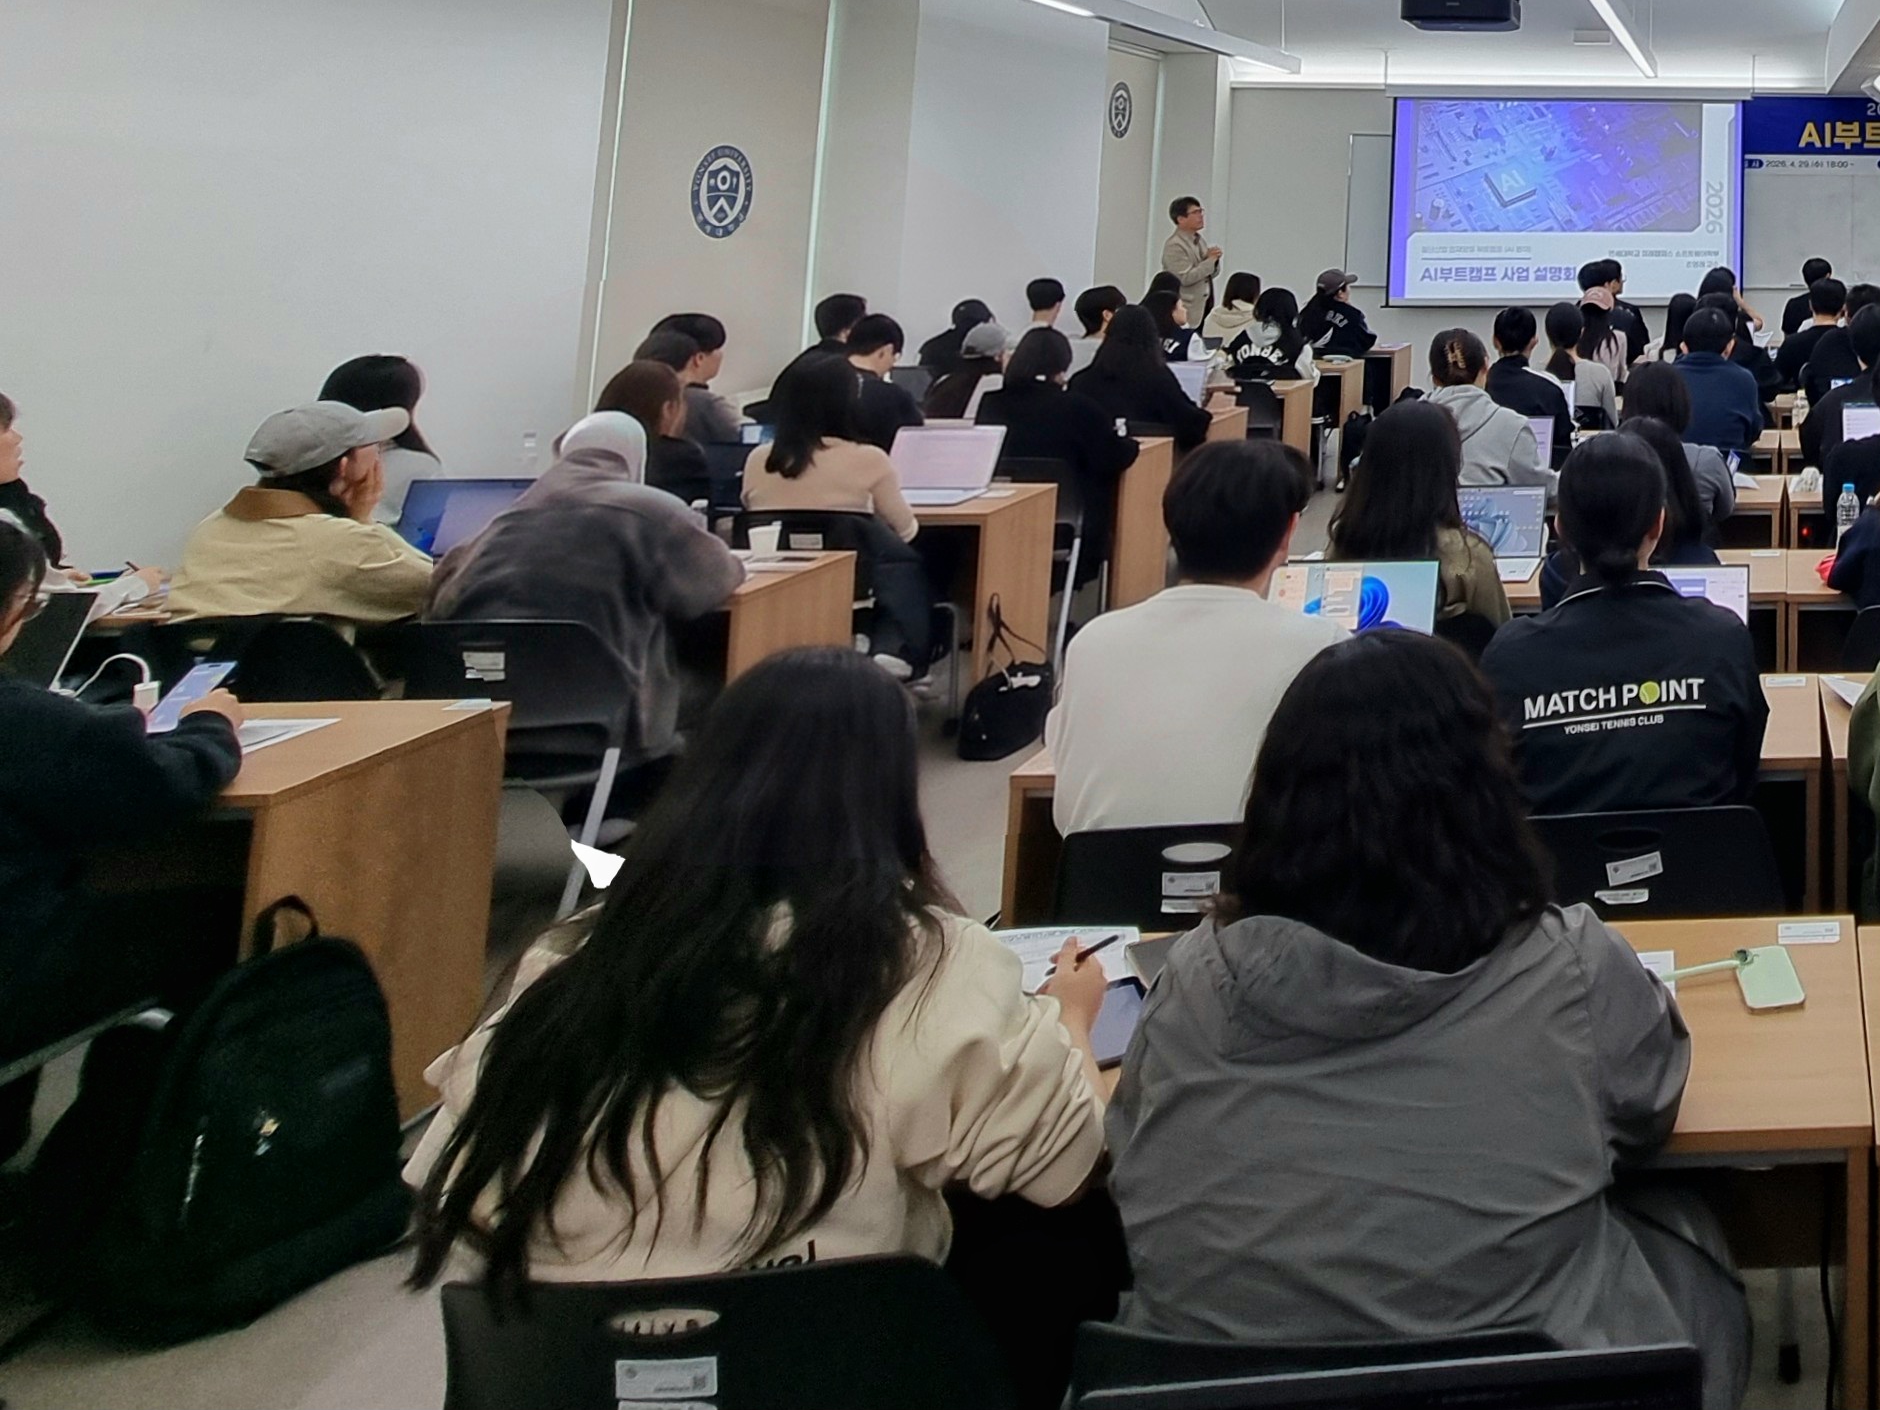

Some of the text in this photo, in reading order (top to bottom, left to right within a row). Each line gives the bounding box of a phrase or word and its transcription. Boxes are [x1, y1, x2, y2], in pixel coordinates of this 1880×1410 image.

[1706, 181, 1724, 235] 2026
[1420, 265, 1577, 282] AI부트캠프 사업 설명회
[1523, 677, 1705, 721] MATCH POINT
[1563, 714, 1665, 735] YONSEI TENNIS CLUB
